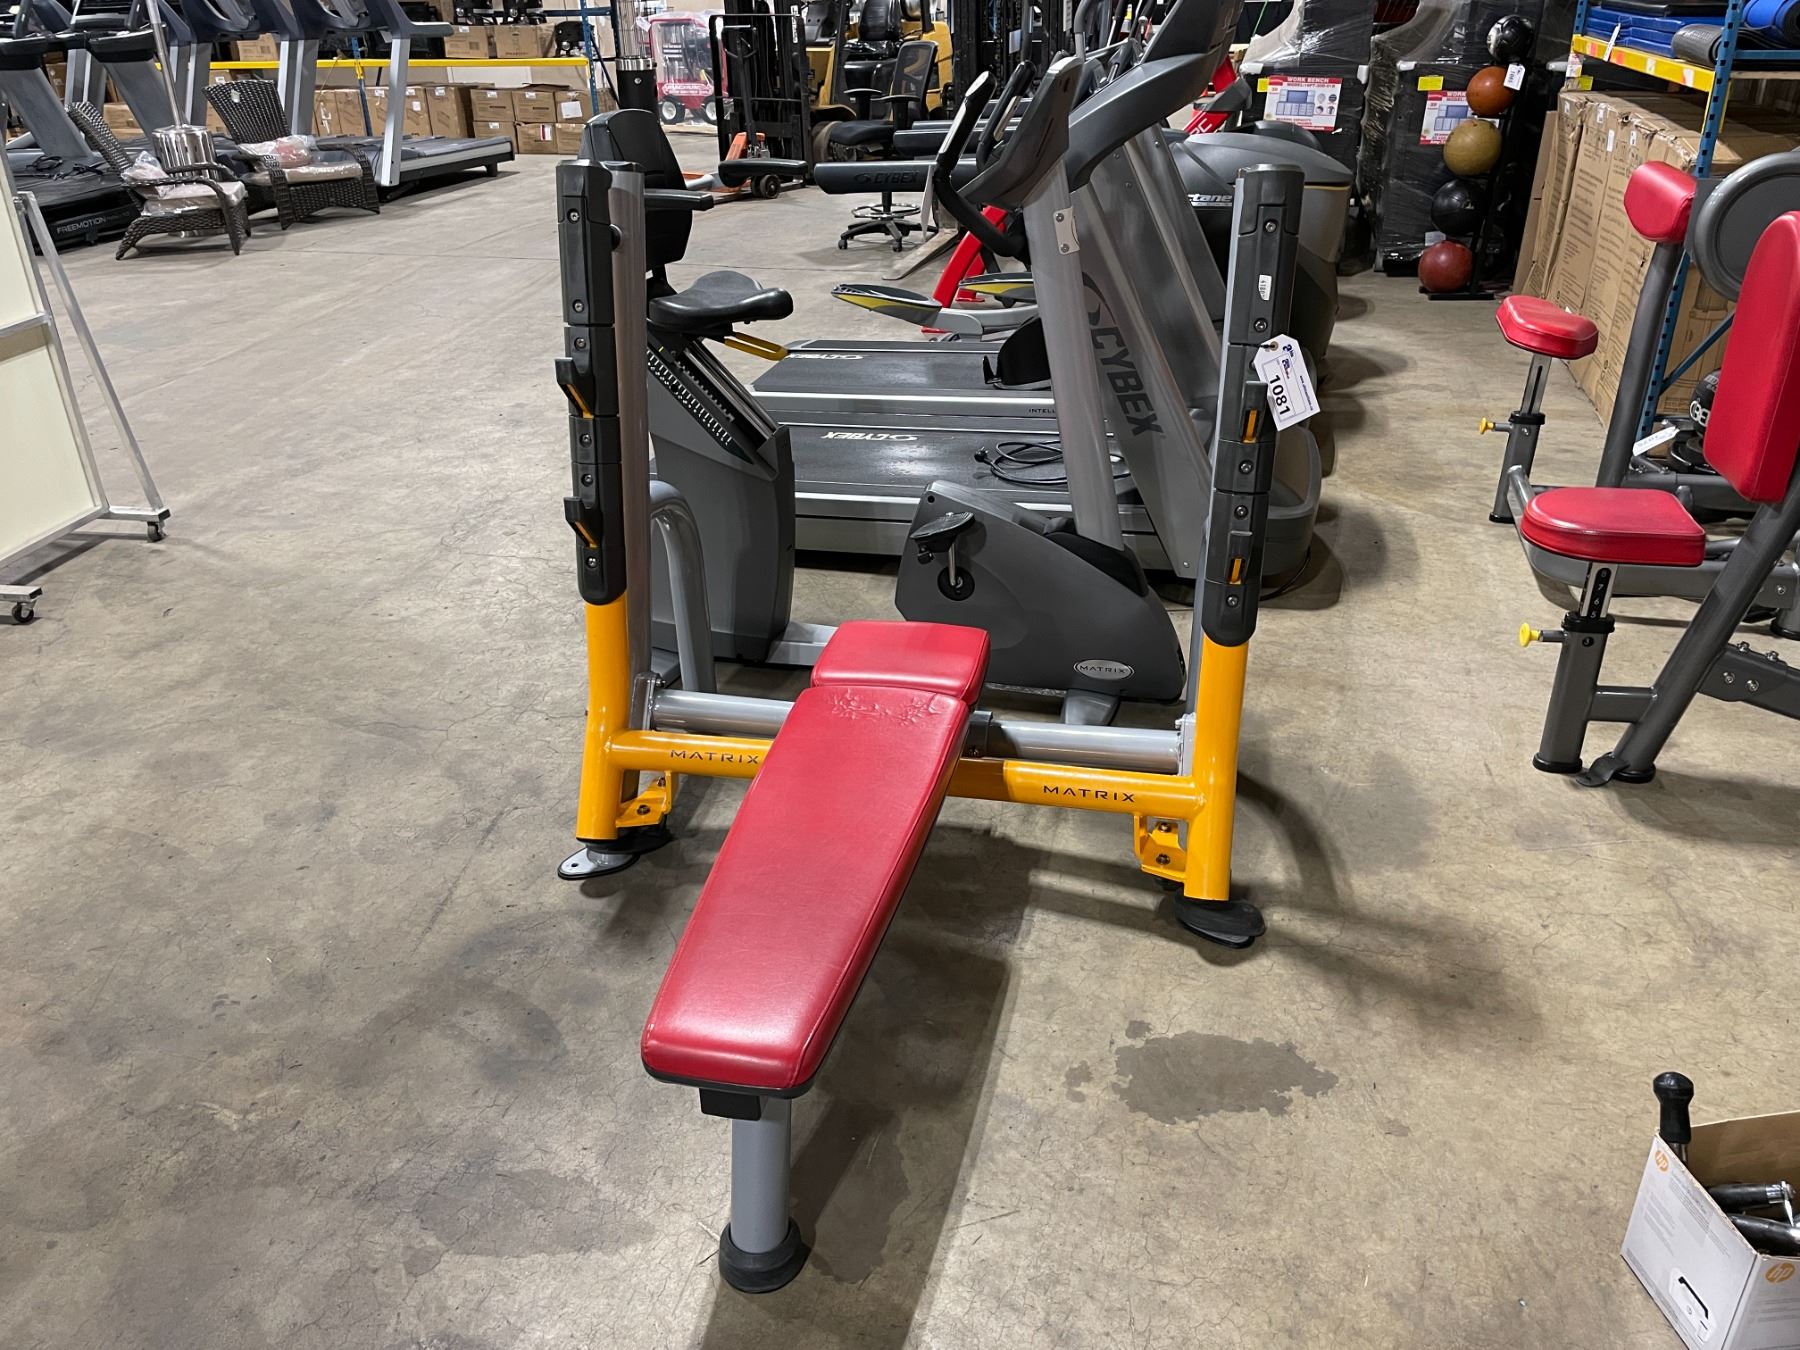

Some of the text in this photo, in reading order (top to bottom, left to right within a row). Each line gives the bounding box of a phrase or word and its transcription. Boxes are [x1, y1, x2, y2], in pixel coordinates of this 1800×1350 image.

[56, 217, 107, 235] FREEMOTION
[1091, 326, 1164, 436] CYBEX
[1269, 374, 1291, 415] 1081
[1079, 665, 1126, 674] MATRIX
[670, 749, 759, 764] MATRIX
[1043, 785, 1135, 803] MATRIX
[1655, 1150, 1669, 1172] hp
[1765, 1262, 1796, 1283] hp
